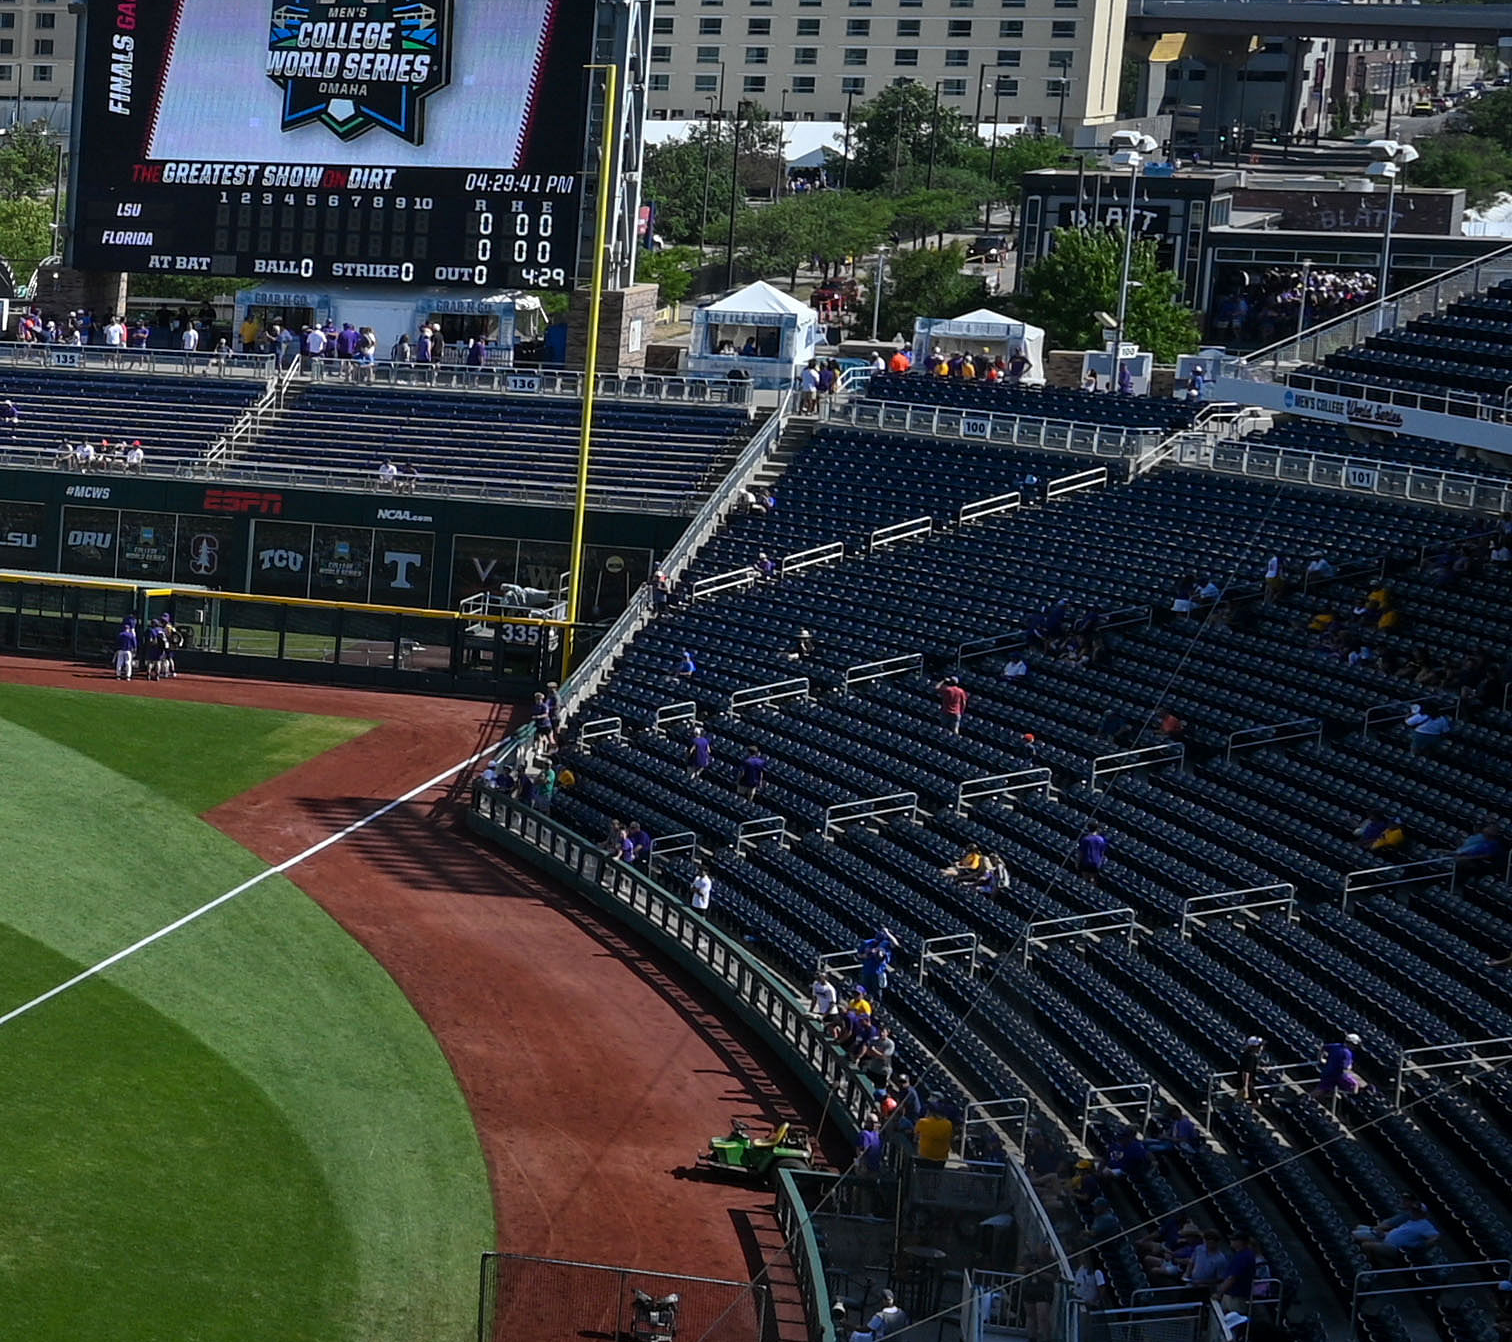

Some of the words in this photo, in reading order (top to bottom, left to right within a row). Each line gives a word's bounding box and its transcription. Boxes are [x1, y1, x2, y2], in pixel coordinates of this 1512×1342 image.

[328, 7, 367, 18] MEN'S
[297, 21, 396, 50] COLLEGE
[108, 34, 135, 116] FINALS
[266, 50, 341, 78] WORLD
[342, 53, 431, 83] SERIES
[319, 82, 367, 96] OMAHA
[132, 163, 161, 182] THE
[162, 163, 259, 186] GREATEST
[262, 166, 324, 188] SHOW
[323, 170, 347, 188] ON
[346, 168, 396, 190] DIRT
[465, 173, 541, 192] 04:29:41
[546, 175, 574, 193] PM
[219, 191, 229, 204] 1
[240, 192, 251, 205] 2
[262, 192, 273, 205] 3
[283, 193, 295, 206] 4
[305, 194, 317, 207] 5
[328, 195, 339, 207] 6
[350, 195, 362, 207] 7
[372, 196, 384, 208] 8
[395, 197, 406, 209] 9
[413, 197, 433, 210] 10
[474, 199, 487, 211] R
[511, 200, 523, 212] H
[541, 201, 552, 213] E
[117, 203, 142, 218] LSU
[479, 212, 493, 235] 0
[516, 213, 529, 236] 0
[539, 214, 552, 237] 0
[1319, 208, 1403, 229] BLATT
[101, 231, 154, 246] FLORIDA
[478, 238, 491, 261] 0
[514, 239, 527, 262] 0
[537, 240, 550, 263] 0
[148, 255, 172, 270] AT
[176, 256, 210, 271] BAT
[254, 259, 300, 275] BALL
[300, 258, 313, 277] 0
[332, 262, 399, 279] STRIKE
[401, 262, 414, 281] 0
[435, 266, 472, 282] OUT
[474, 265, 487, 284] 0
[521, 268, 565, 287] 4:29
[255, 291, 280, 305] GRAB
[437, 300, 463, 311] GRAB
[56, 355, 75, 364] 135
[513, 379, 535, 389] 136
[1294, 394, 1315, 409] MEN'S
[1316, 397, 1345, 415] COLLEGE
[1346, 399, 1372, 419] World
[1374, 404, 1403, 425] Series
[966, 422, 986, 433] 100
[1352, 472, 1370, 484] 101
[65, 486, 111, 500] #MCWS
[203, 489, 284, 516] ESPN
[376, 508, 432, 524] NCAA.com
[259, 547, 306, 572] TCU
[383, 550, 423, 589] T
[501, 623, 540, 643] 335
